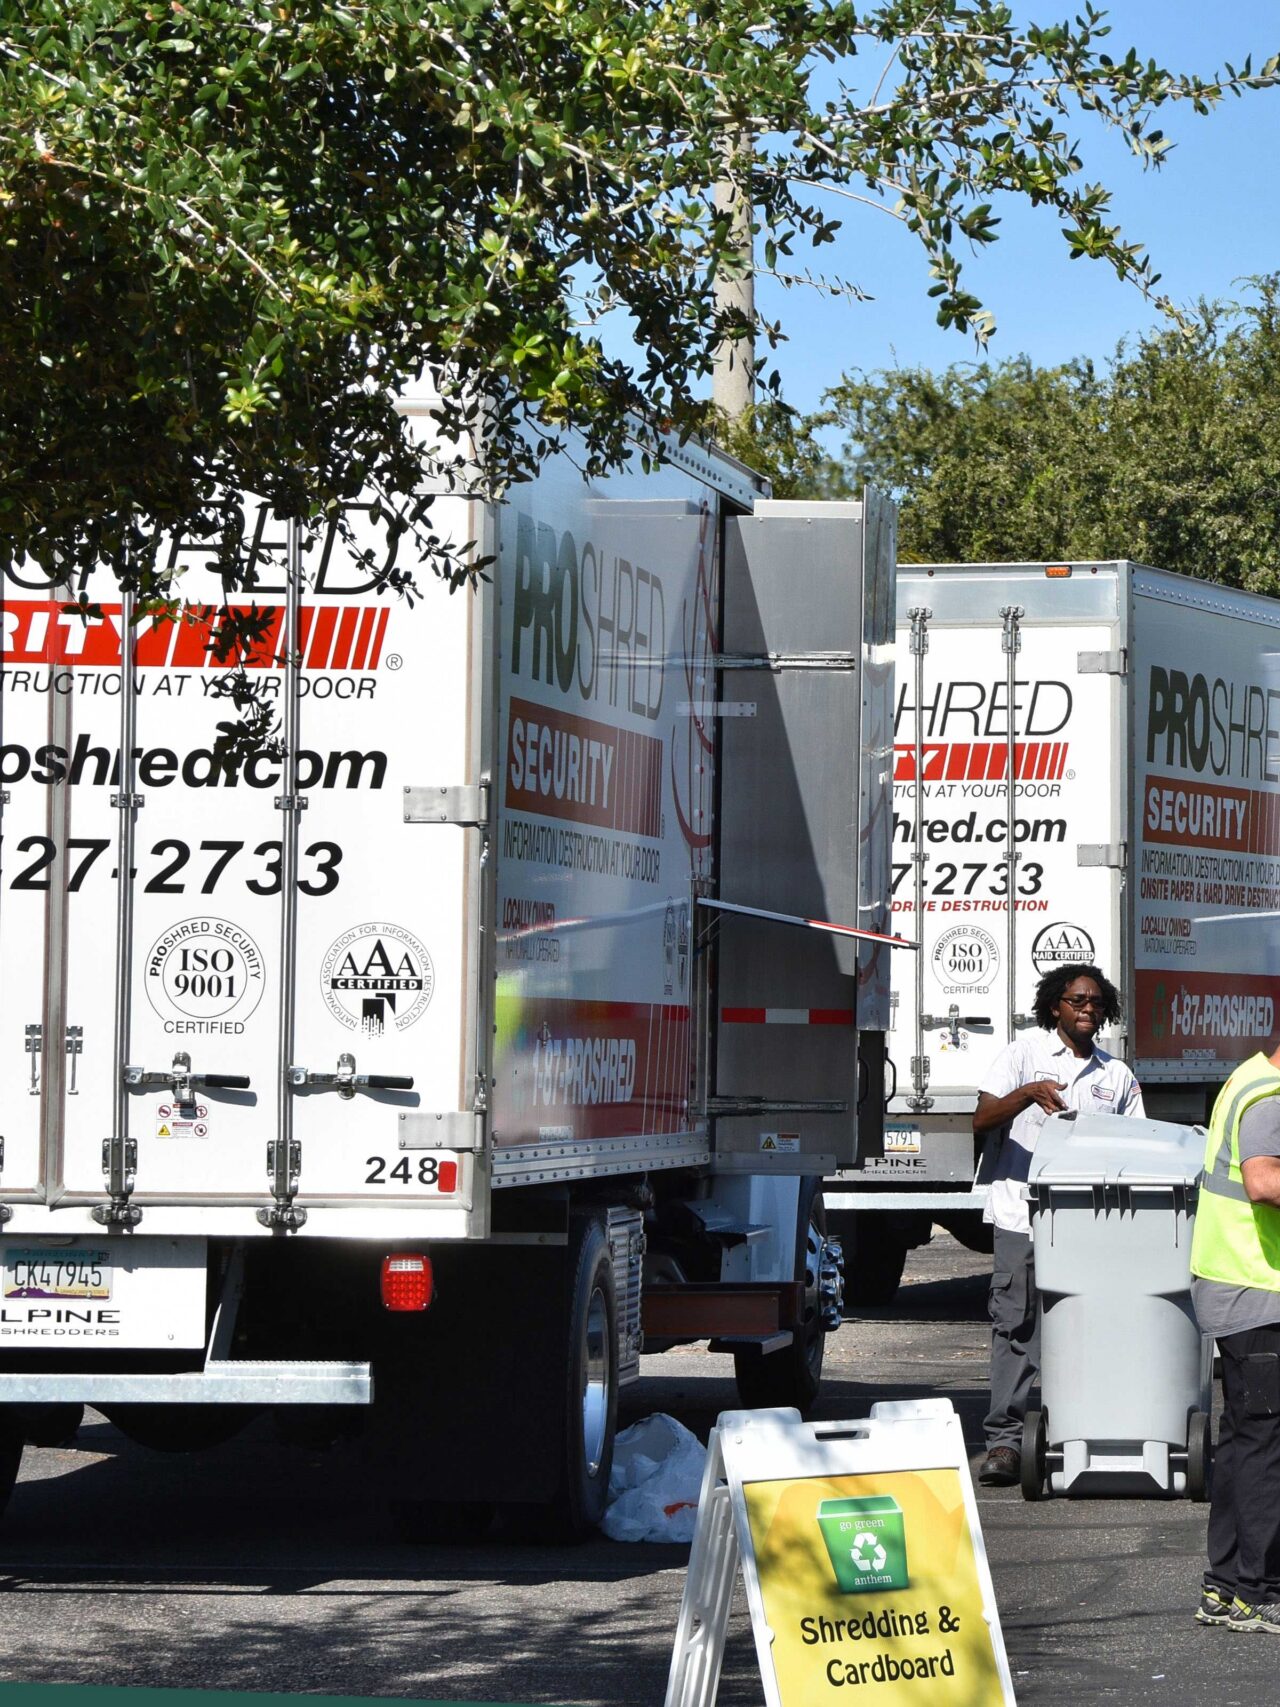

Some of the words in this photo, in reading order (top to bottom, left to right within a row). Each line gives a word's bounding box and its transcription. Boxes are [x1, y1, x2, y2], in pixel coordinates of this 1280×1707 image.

[2, 500, 400, 594] RED
[510, 511, 665, 721] PROSHRED
[153, 674, 192, 697] AT
[296, 677, 377, 699] DOOR
[893, 680, 1073, 737] HRED
[510, 717, 614, 808] SECURITY
[935, 784, 957, 798] AT
[961, 784, 1008, 798] YOUR
[1013, 784, 1061, 798] DOOR
[892, 811, 1067, 843] hred.com
[1147, 786, 1247, 841] SECURITY
[0, 835, 344, 896] 27-2733
[504, 820, 558, 865] INFORMATION
[558, 830, 610, 874] DESTRUCTION
[620, 842, 641, 881] YOUR
[641, 847, 660, 884] DOOR
[892, 862, 1044, 895] 7-2733
[1141, 849, 1194, 877] INFORMATION
[1195, 856, 1244, 882] DESTRUCTION
[1245, 860, 1254, 883] AT
[1255, 862, 1274, 885] YOUR
[1171, 879, 1194, 902] PAPER
[892, 901, 936, 912] DRVE
[941, 900, 1048, 912] DESTRUCTION
[359, 925, 377, 935] FOR
[1044, 930, 1083, 949] AAA
[149, 921, 210, 977] PROSHRED
[214, 923, 261, 979] SECURITY
[179, 948, 234, 972] ISO
[323, 931, 356, 985] ASSOCIATION
[336, 938, 418, 977] AAA
[382, 926, 431, 971] INFORMATION
[952, 943, 982, 957] ISO
[1033, 951, 1053, 960] NAID
[1055, 951, 1095, 960] CERTIFIED
[948, 958, 983, 973] 9001
[174, 973, 237, 998] 9001
[337, 979, 418, 989] CERTIFIED
[943, 986, 989, 994] CERTIFIED
[395, 975, 432, 1029] DESTRUCTION
[1171, 994, 1274, 1037] 1-87-PROSHRED
[163, 1020, 245, 1034] CERTIFIED
[364, 1156, 440, 1186] 248
[865, 1158, 927, 1168] PINE
[14, 1260, 102, 1287] CK47945
[1, 1309, 120, 1323] LPINE
[839, 1519, 852, 1531] go
[854, 1517, 885, 1530] green
[854, 1573, 892, 1586] anthem
[800, 1608, 930, 1644] Shredding
[938, 1605, 960, 1633] &
[826, 1648, 955, 1688] Cardboard
